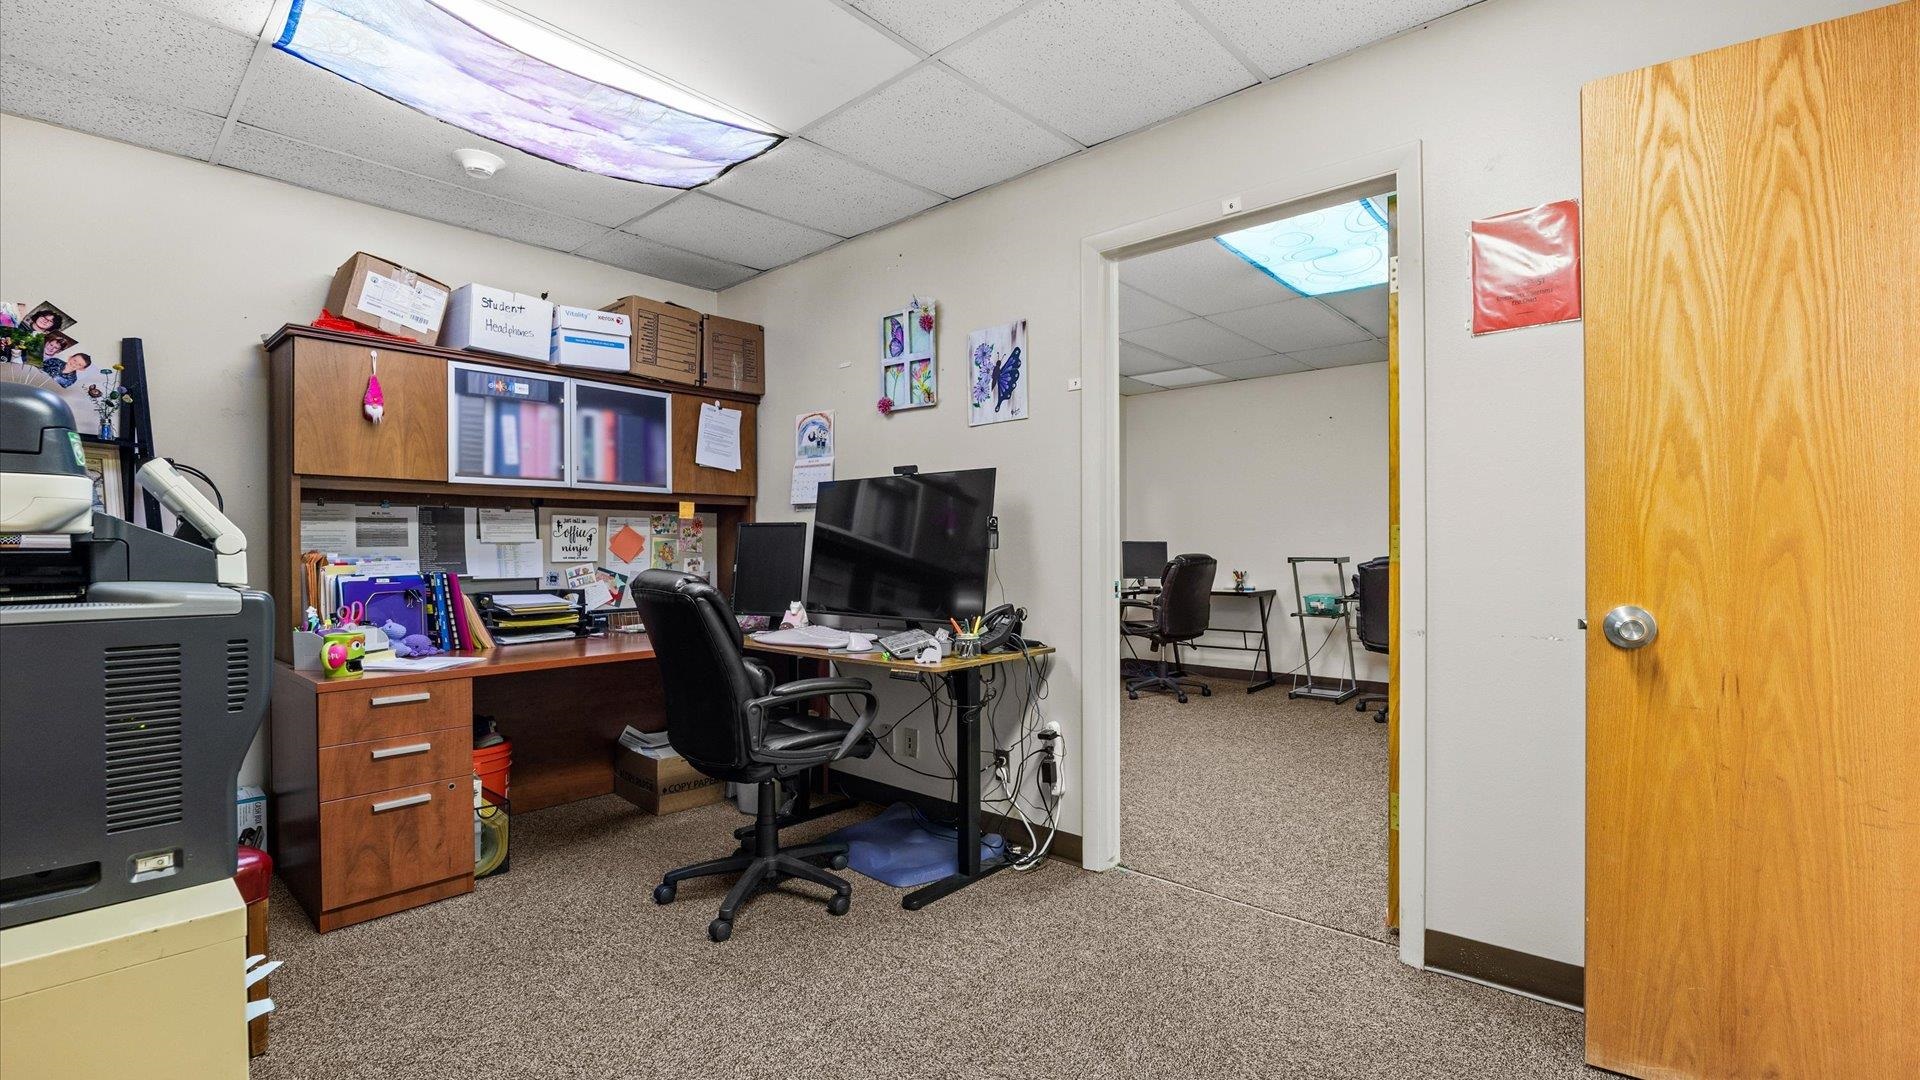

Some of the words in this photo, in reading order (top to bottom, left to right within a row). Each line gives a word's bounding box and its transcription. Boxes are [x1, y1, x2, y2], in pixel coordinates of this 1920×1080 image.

[481, 297, 526, 314] Student
[565, 310, 588, 320] Vitality
[486, 318, 535, 338] Headphones
[556, 525, 594, 543] office
[561, 544, 590, 556] ninja
[668, 781, 692, 793] COPY
